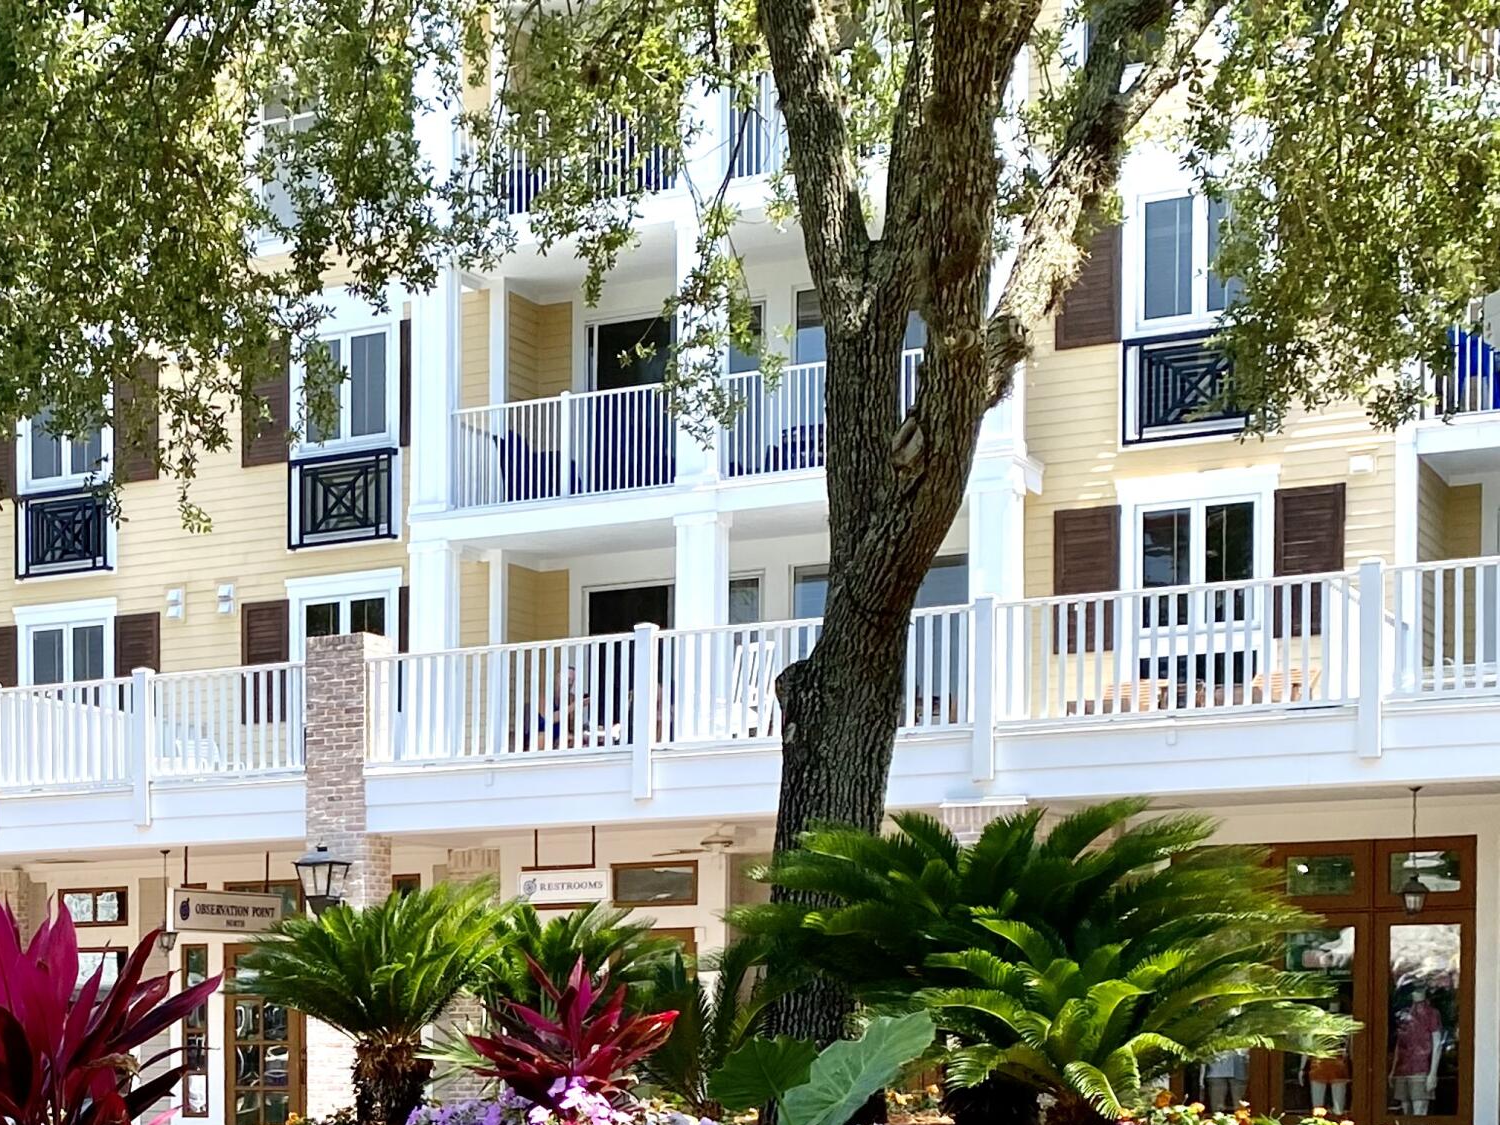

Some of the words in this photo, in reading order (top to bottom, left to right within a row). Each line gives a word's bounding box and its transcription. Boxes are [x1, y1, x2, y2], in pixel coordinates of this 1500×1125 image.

[540, 881, 603, 891] RESTROOMS
[195, 903, 249, 917] OBSERVATION
[252, 906, 275, 918] POINT
